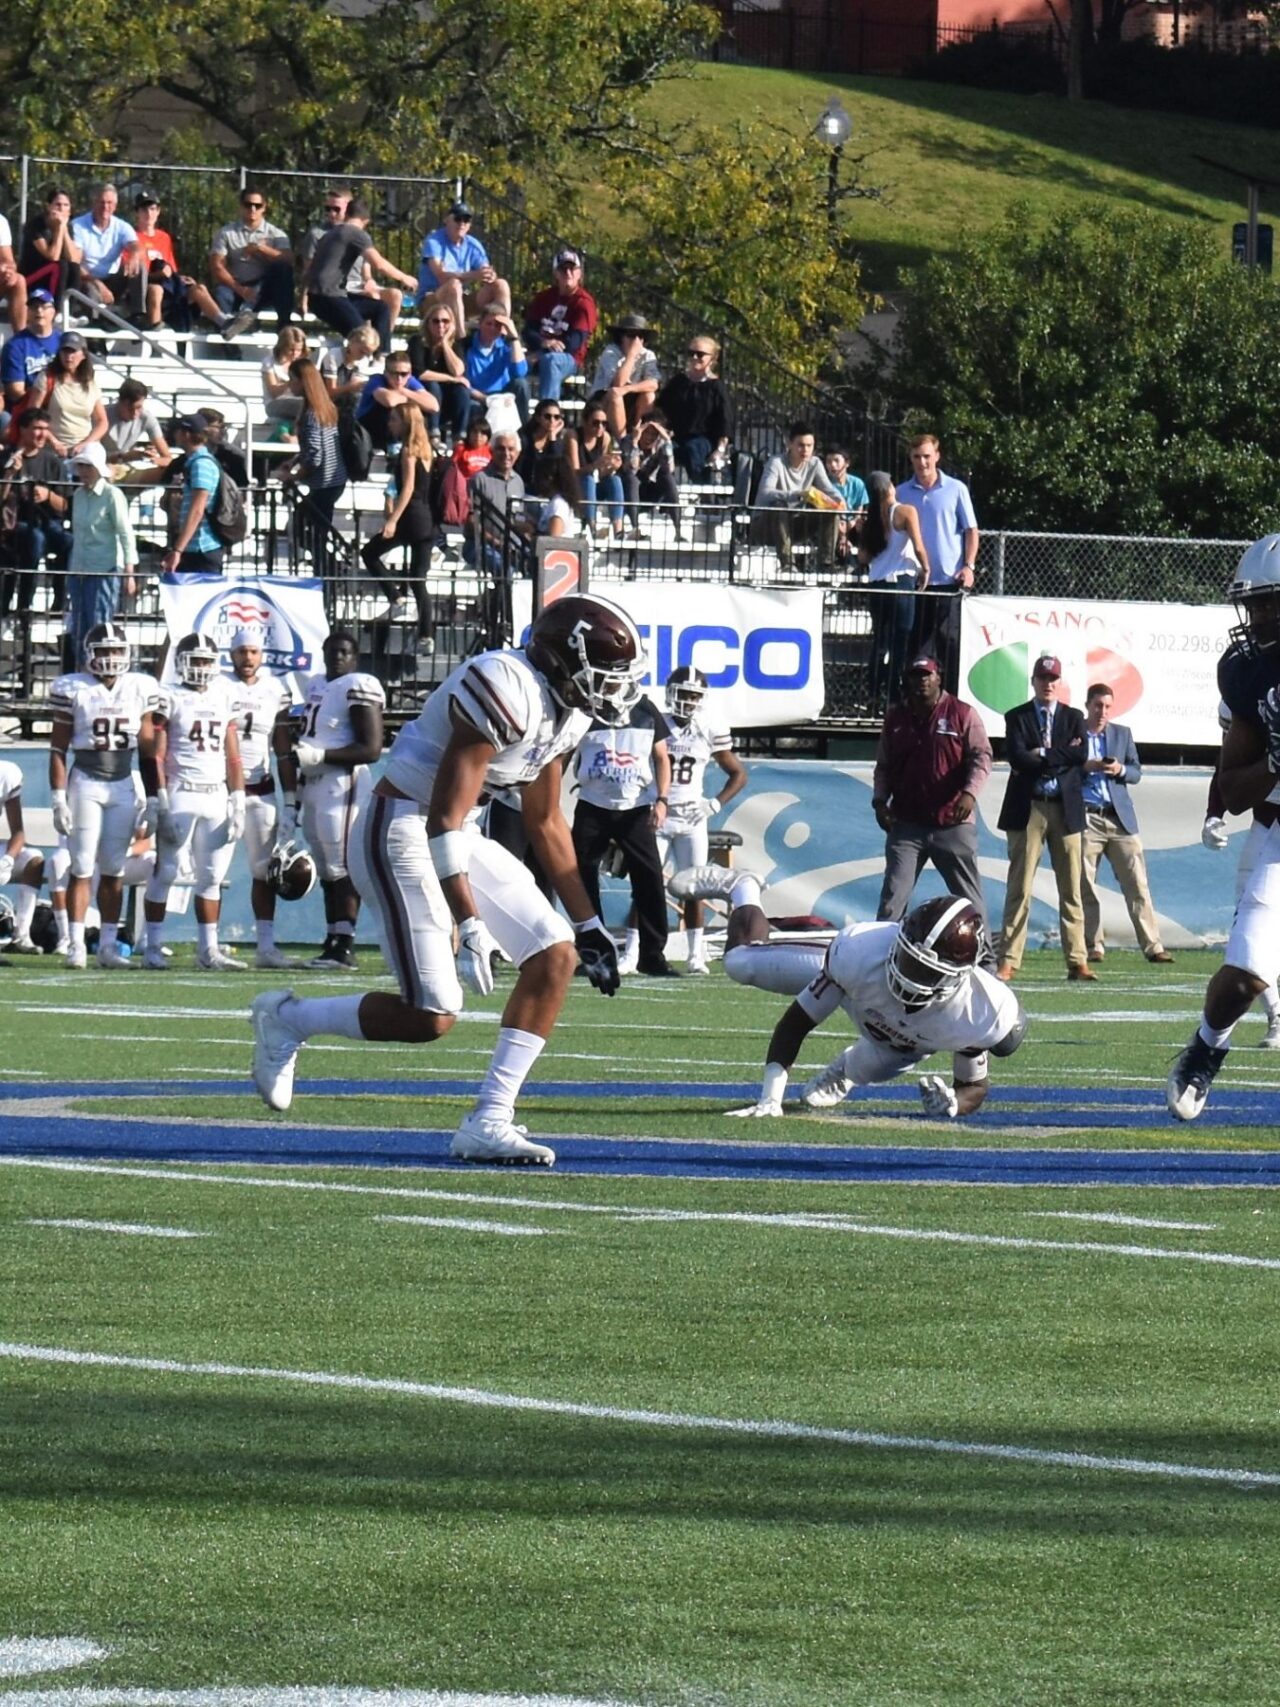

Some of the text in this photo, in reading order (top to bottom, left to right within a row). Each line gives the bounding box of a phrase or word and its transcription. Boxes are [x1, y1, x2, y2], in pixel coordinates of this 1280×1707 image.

[543, 550, 580, 609] 2
[520, 624, 812, 690] ICO
[93, 717, 130, 751] 95
[189, 719, 222, 752] 45
